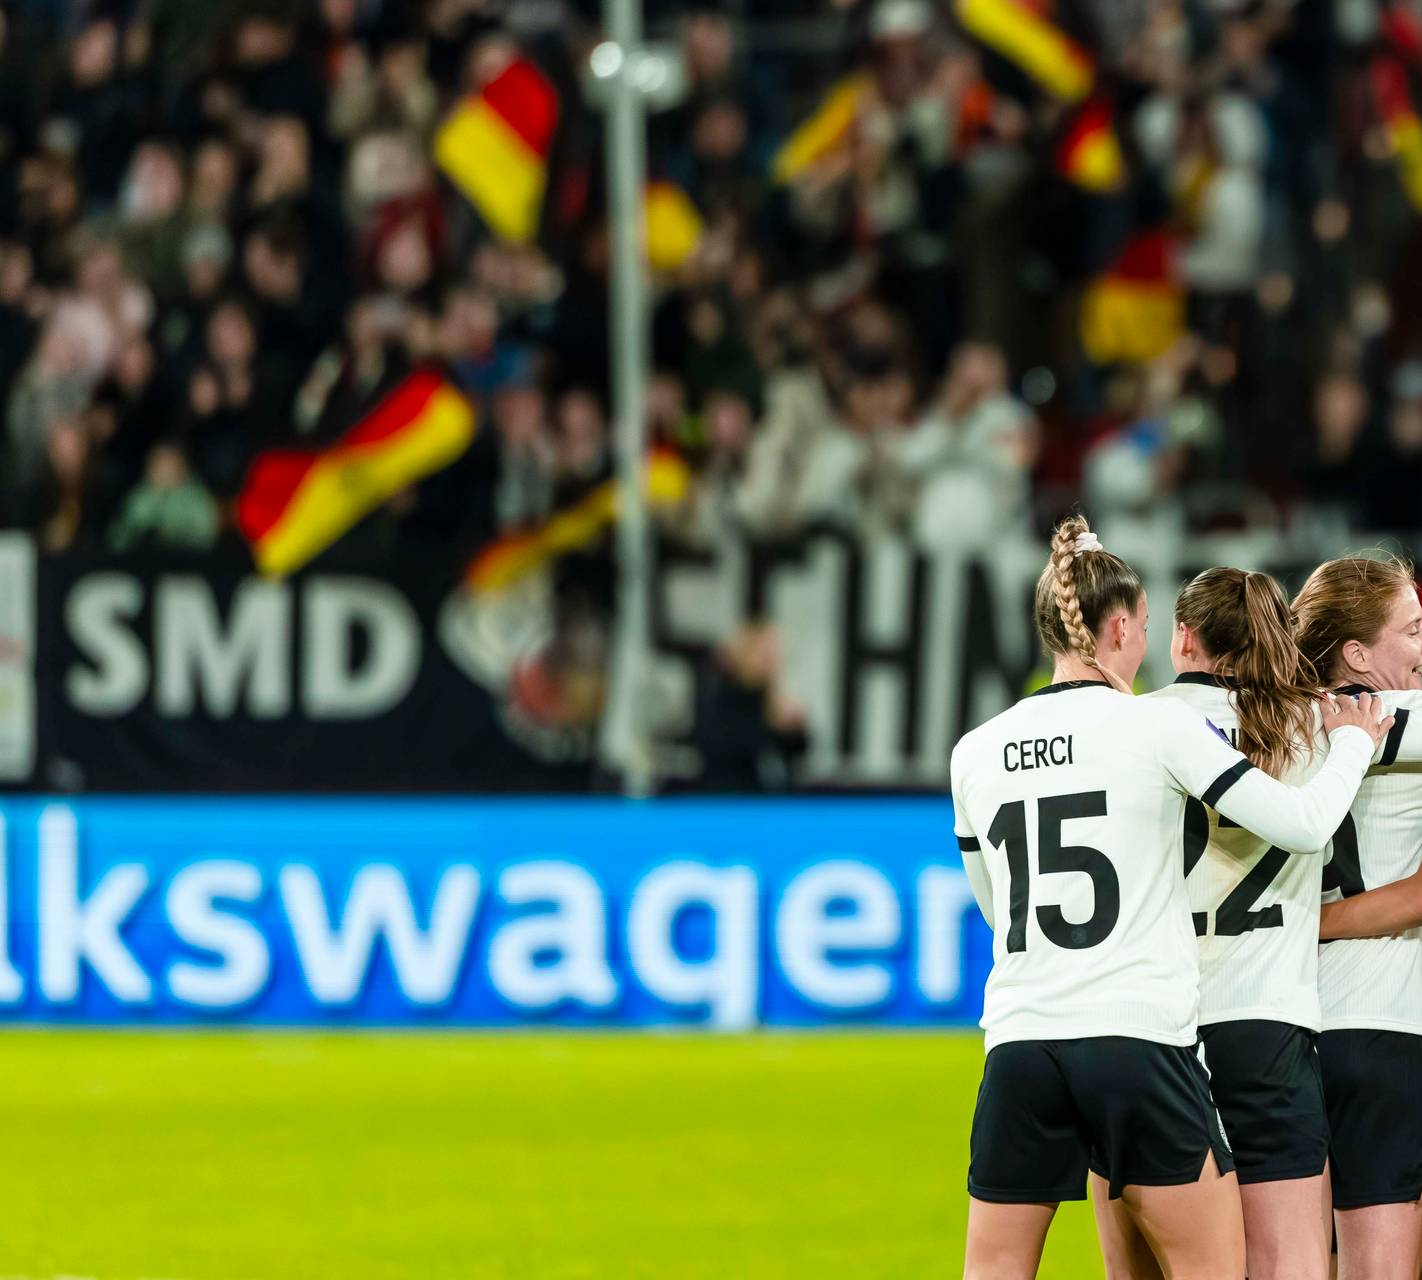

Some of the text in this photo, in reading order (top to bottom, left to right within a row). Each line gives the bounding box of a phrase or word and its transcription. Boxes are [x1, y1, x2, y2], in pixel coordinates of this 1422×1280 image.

[65, 572, 421, 720] SMD
[1004, 735, 1073, 772] CERCI
[987, 790, 1121, 954] 15
